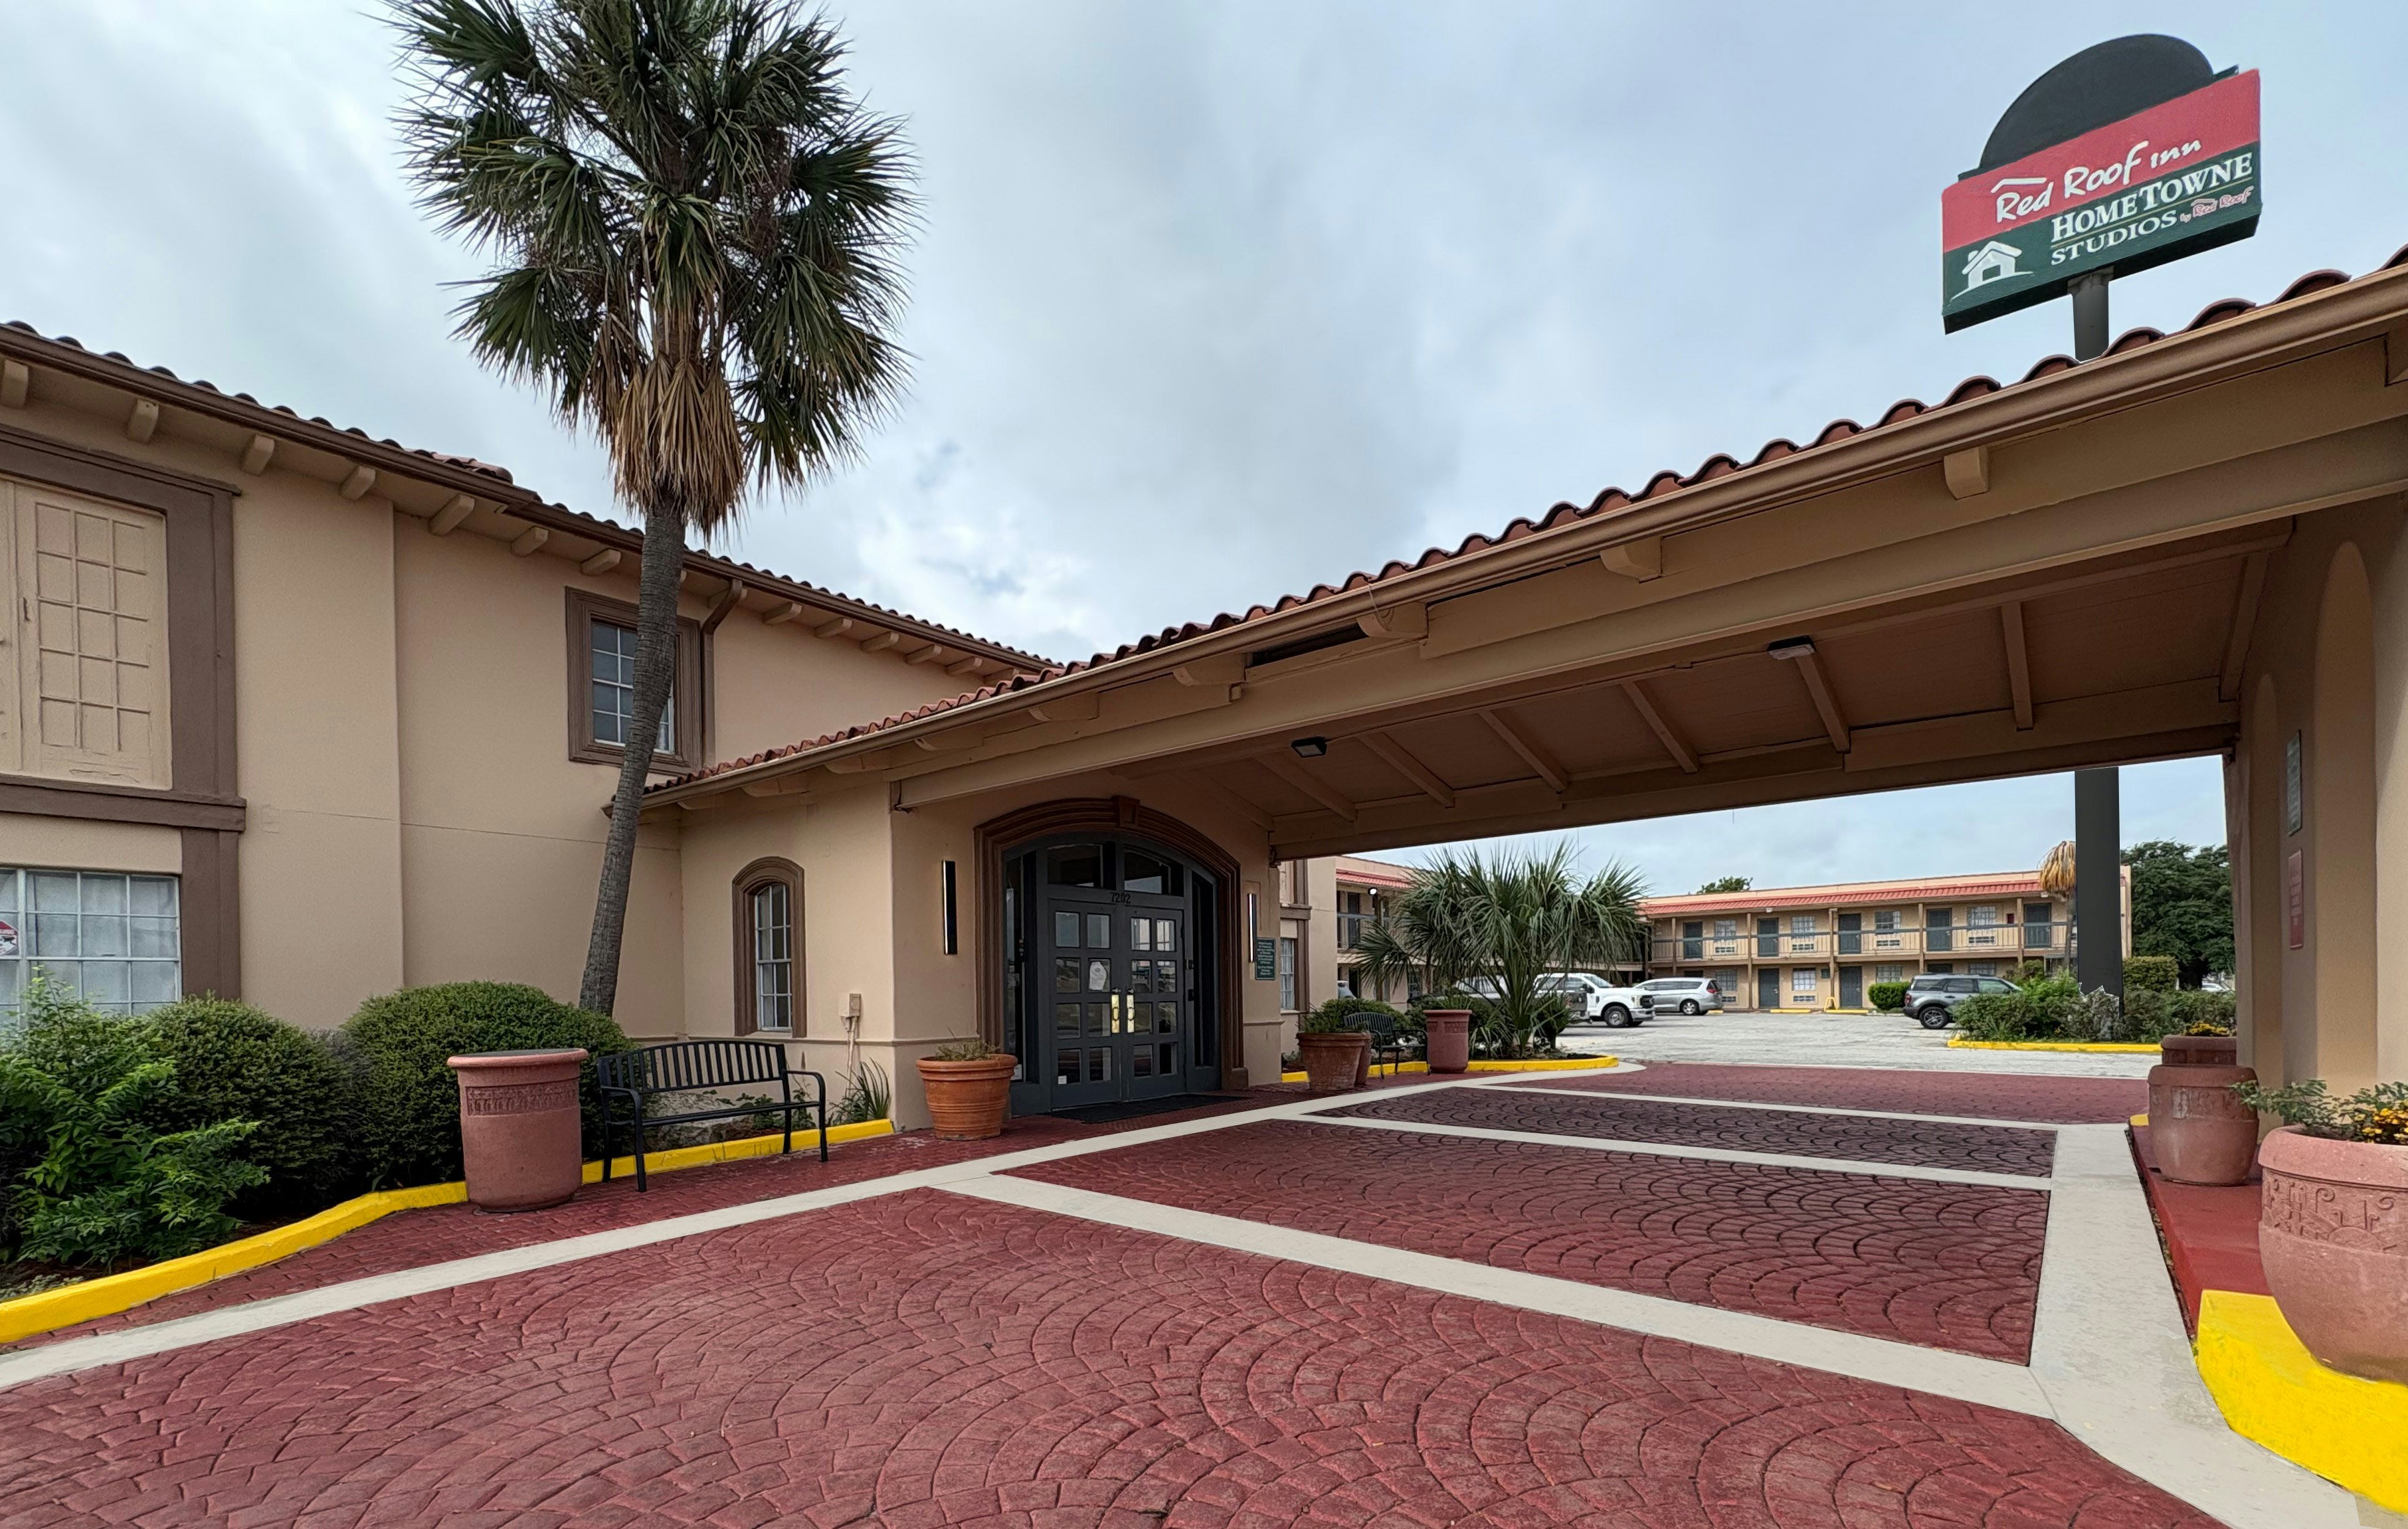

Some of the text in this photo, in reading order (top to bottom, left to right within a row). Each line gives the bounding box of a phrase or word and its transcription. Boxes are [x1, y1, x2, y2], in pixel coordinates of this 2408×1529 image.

[1996, 181, 2054, 223] Red
[2064, 140, 2149, 199] Roof
[2051, 152, 2253, 243] HOMETOWNE
[2051, 209, 2177, 266] STUDIOS
[2192, 199, 2218, 218] Red
[2219, 185, 2255, 209] Roof
[1110, 892, 1131, 904] 7202
